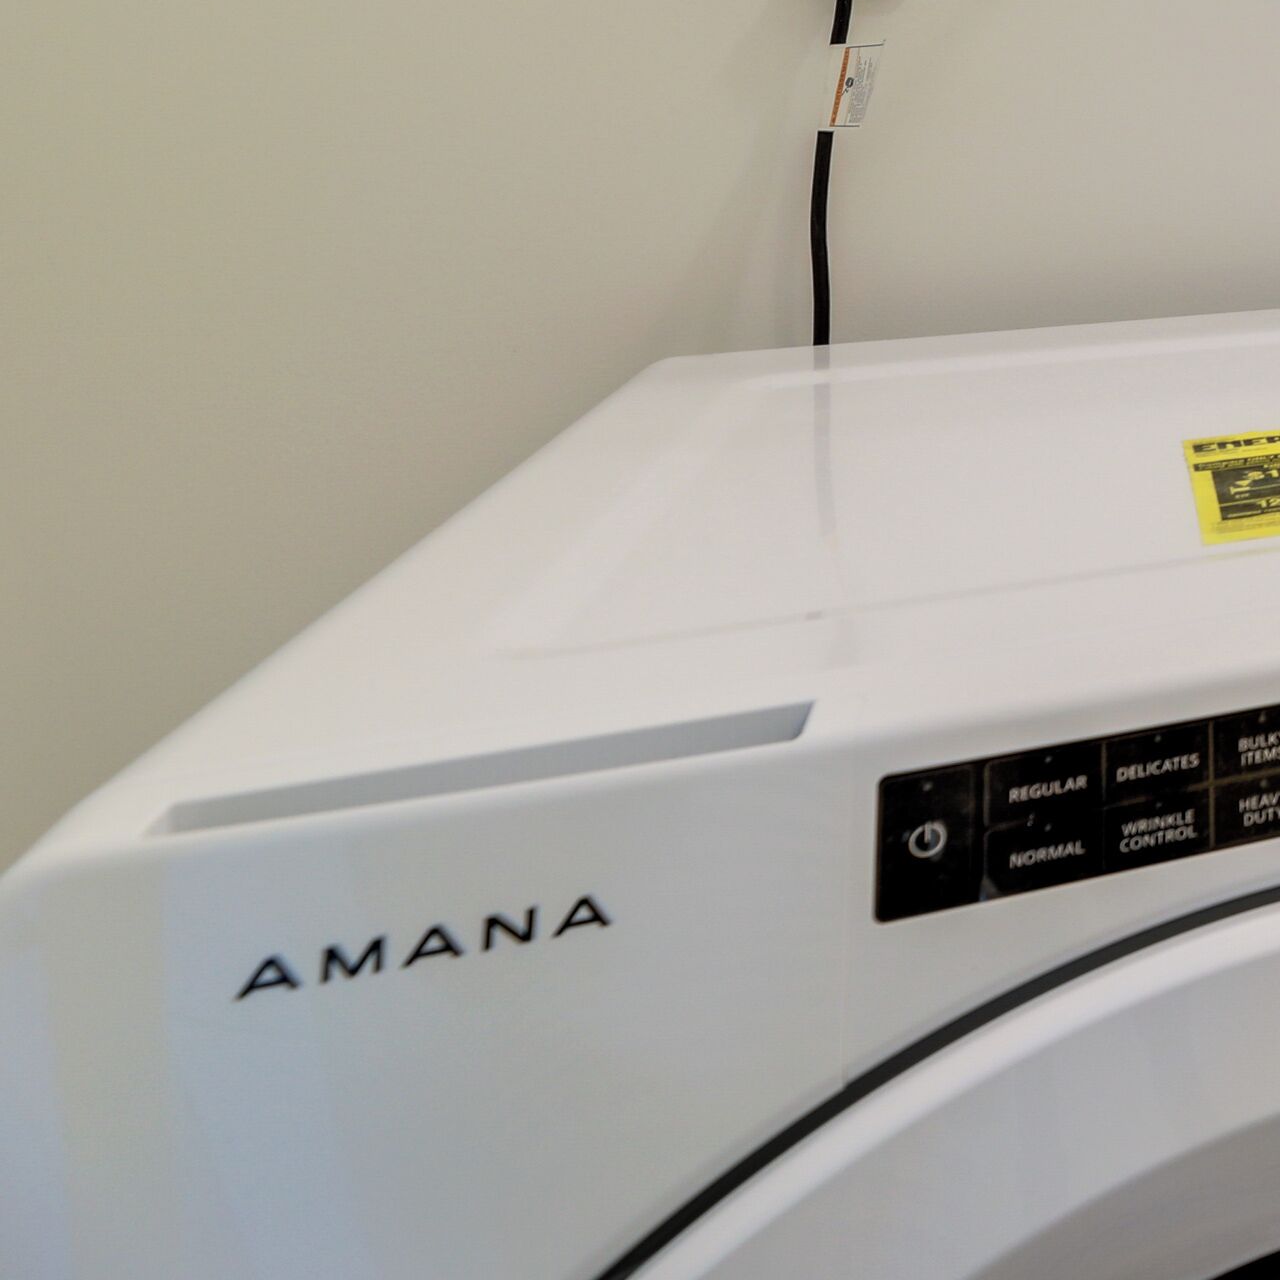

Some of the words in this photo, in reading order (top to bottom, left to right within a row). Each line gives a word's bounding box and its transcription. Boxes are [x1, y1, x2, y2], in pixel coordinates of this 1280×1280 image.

[1116, 752, 1201, 783] DELICATES
[1008, 774, 1088, 804] REGULAR
[1122, 808, 1196, 837] WRINKLE
[1119, 824, 1198, 854] CONTROL
[1009, 840, 1086, 869] NORMAL
[233, 893, 612, 1002] AMANA
